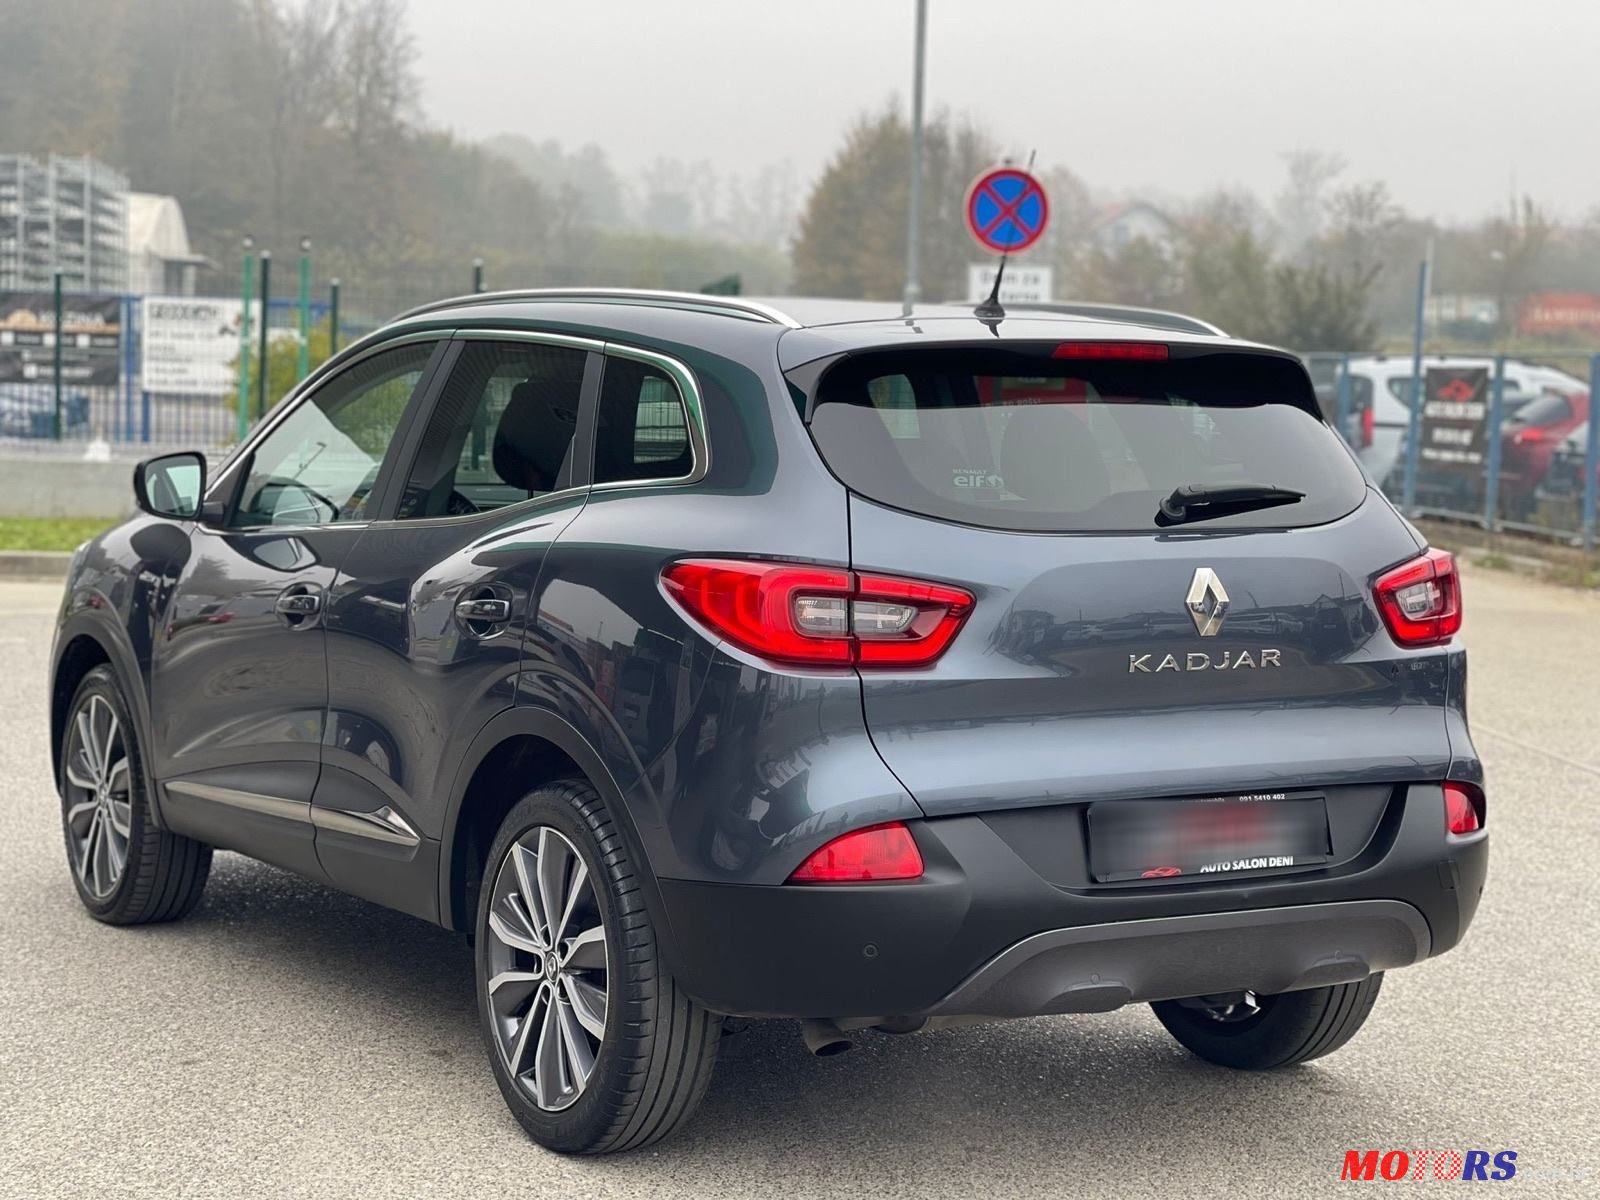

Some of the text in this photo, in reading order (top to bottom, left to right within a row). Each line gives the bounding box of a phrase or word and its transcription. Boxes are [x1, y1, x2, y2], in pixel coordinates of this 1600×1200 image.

[953, 475, 985, 487] elf
[1128, 649, 1281, 673] KADJAR
[1200, 855, 1294, 873] AUTO SALON DENI
